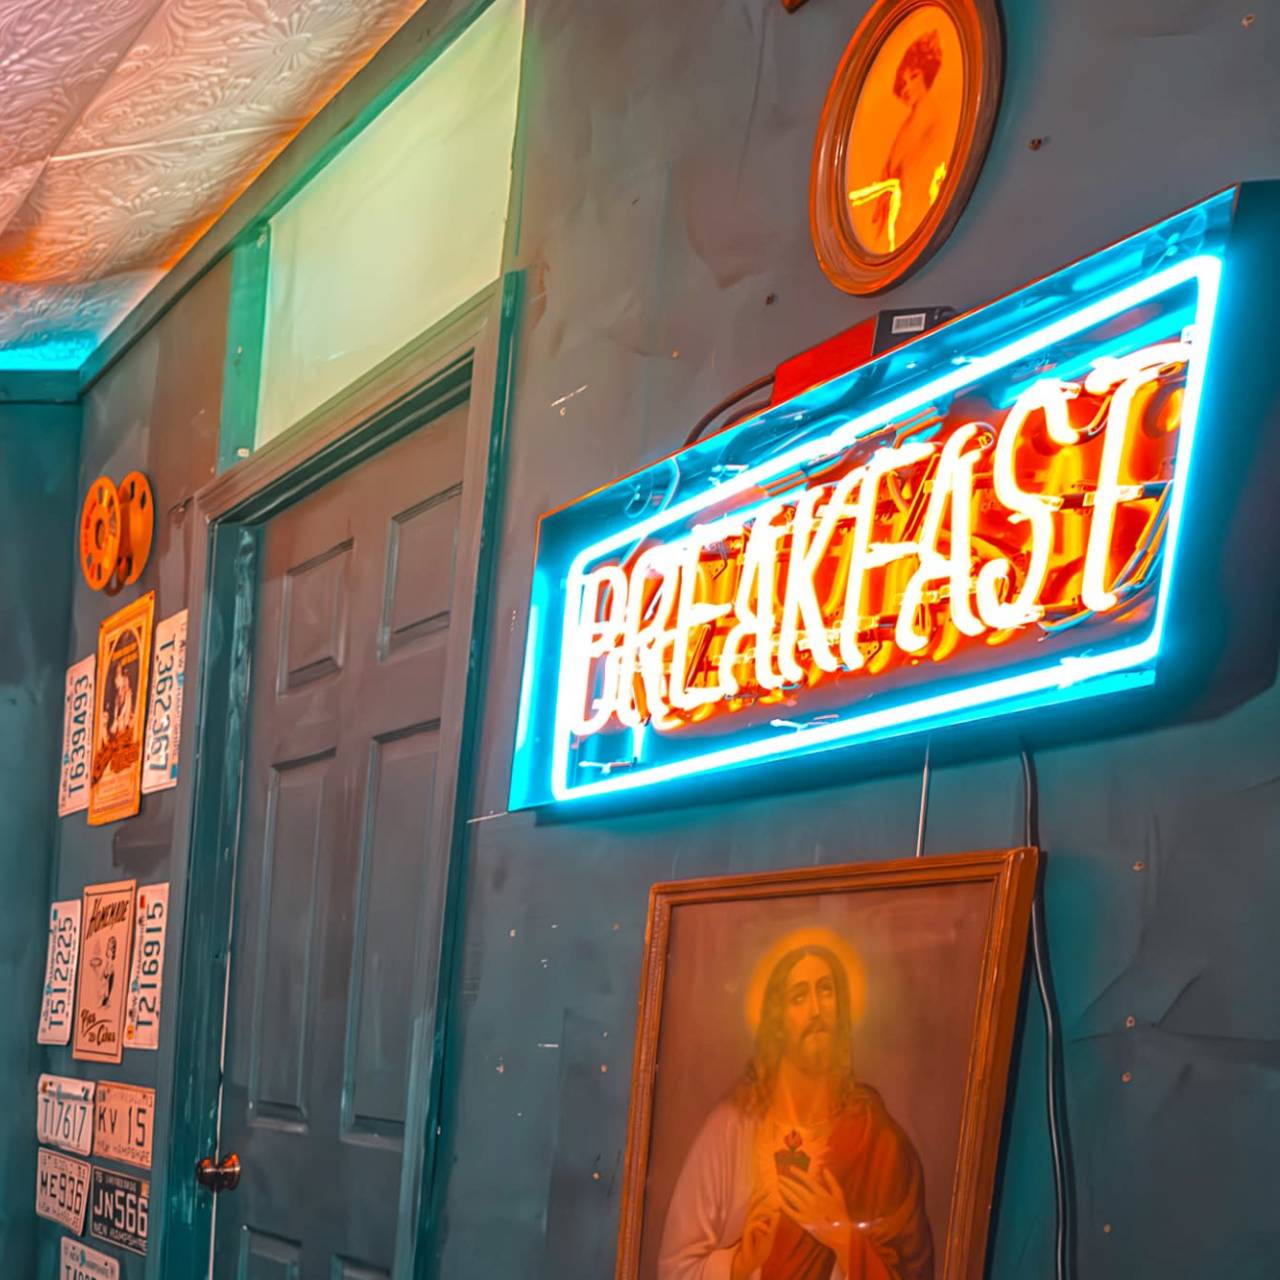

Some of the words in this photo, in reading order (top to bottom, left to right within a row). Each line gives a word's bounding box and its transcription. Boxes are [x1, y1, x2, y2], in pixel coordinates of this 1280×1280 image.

[564, 338, 1197, 737] BREAKFAST
[68, 674, 90, 798] T639493
[149, 632, 176, 772] T362367
[48, 916, 74, 1030] T512225
[85, 897, 130, 941] HOMEMADE
[135, 902, 164, 1031] T216915
[43, 1097, 87, 1145] T17617
[98, 1105, 118, 1135] KV
[127, 1105, 147, 1147] 15
[93, 1188, 149, 1239] JN566
